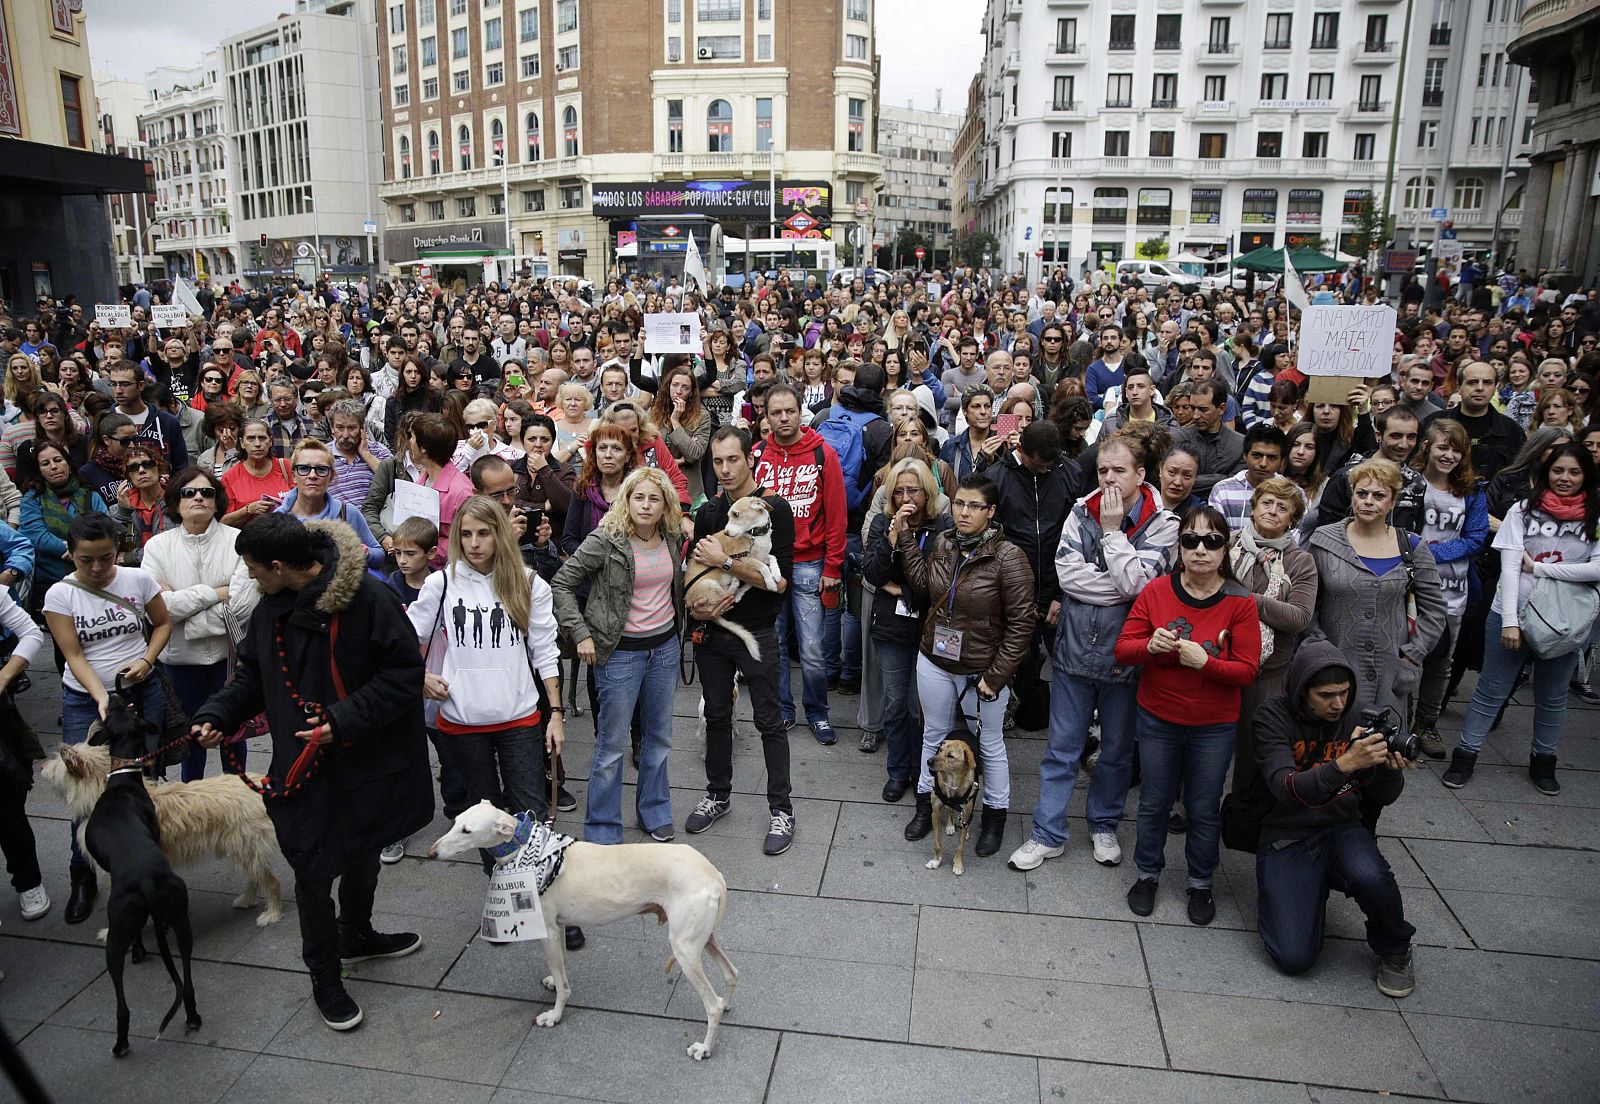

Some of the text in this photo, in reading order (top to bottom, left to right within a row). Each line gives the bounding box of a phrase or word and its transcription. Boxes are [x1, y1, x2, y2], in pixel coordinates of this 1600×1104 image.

[1204, 101, 1228, 110] HOSTAL
[1272, 100, 1332, 108] CONTINENTAL
[598, 191, 625, 207] TODOS
[627, 191, 643, 207] LOS
[645, 188, 683, 207] SÁBADOS
[754, 190, 770, 206] CLU
[1312, 309, 1343, 328] ANA
[755, 461, 820, 485] Chicago
[791, 505, 811, 518] 965
[76, 608, 128, 629] Huella
[78, 622, 141, 643] Animal
